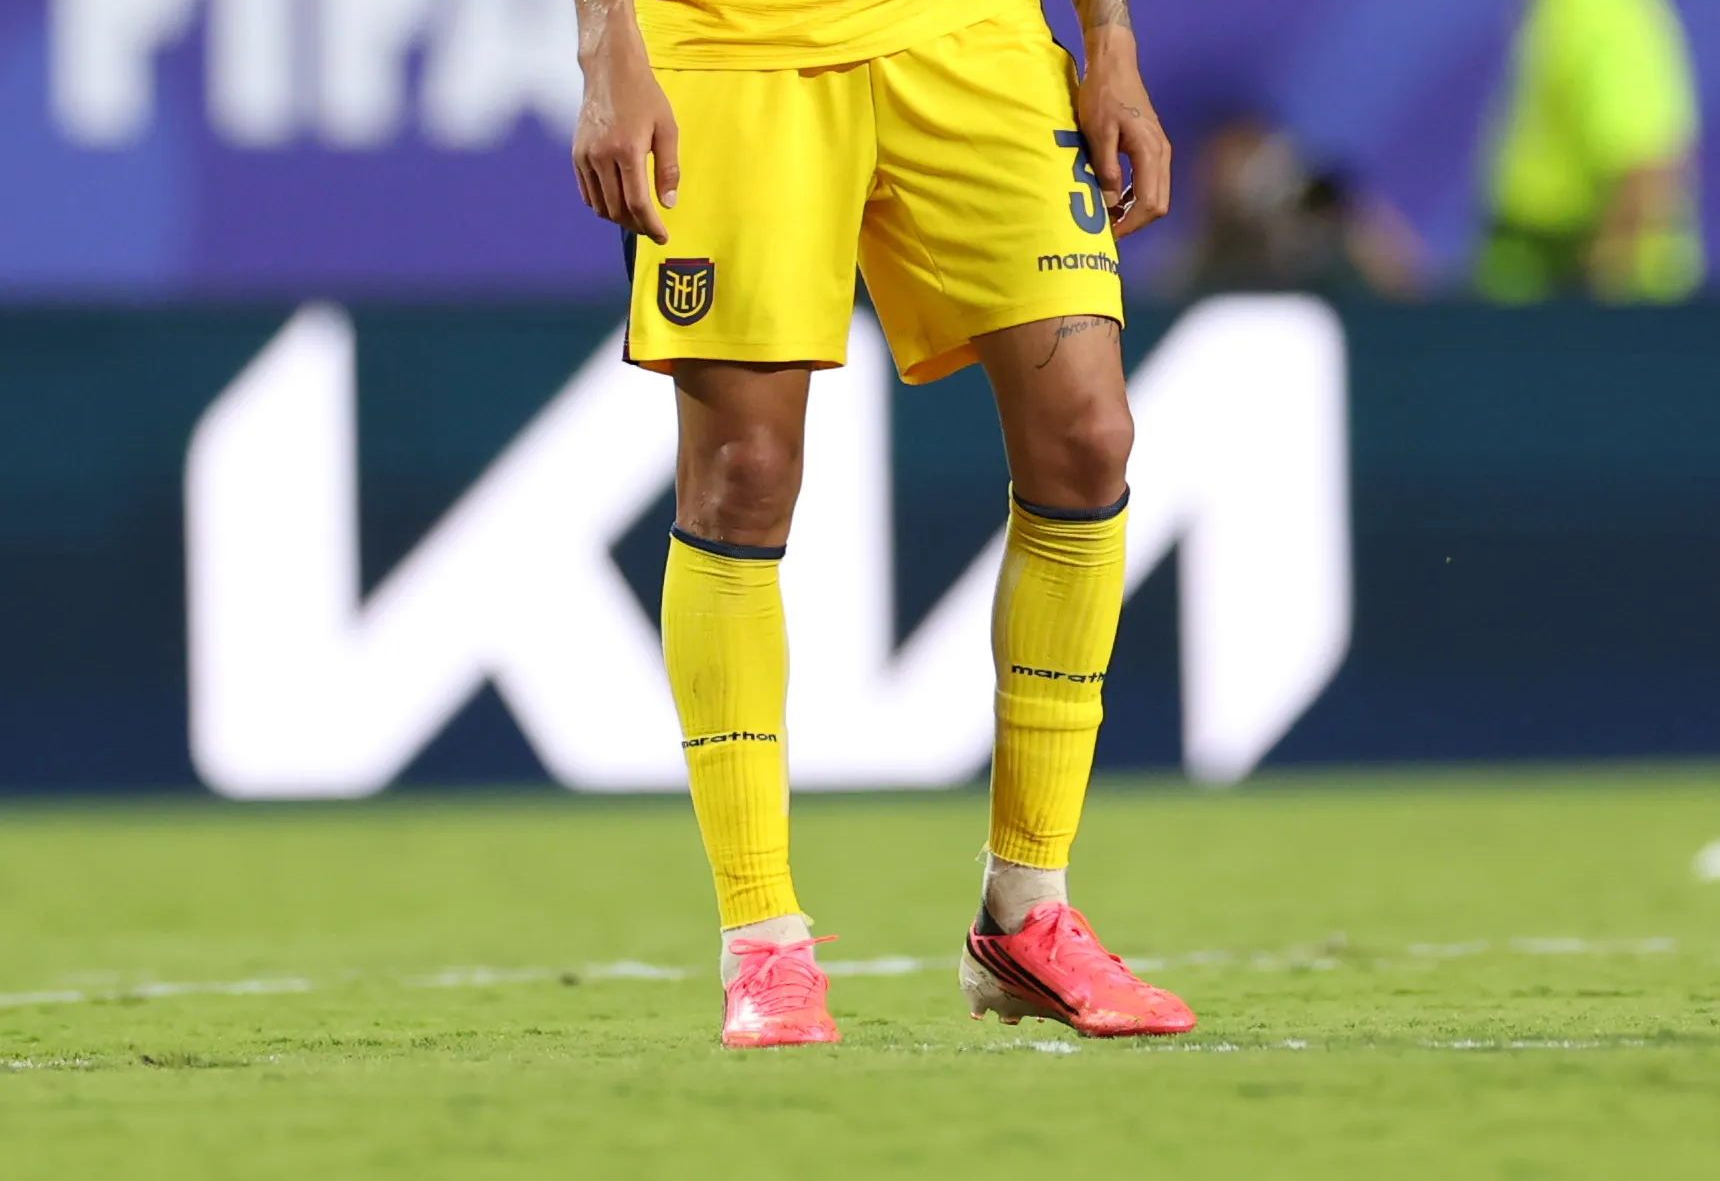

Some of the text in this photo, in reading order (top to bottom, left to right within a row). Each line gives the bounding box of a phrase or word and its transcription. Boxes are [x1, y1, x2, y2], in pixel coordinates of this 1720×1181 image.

[1053, 130, 1108, 235] 3
[1037, 251, 1120, 276] maratho
[1011, 664, 1107, 684] marath
